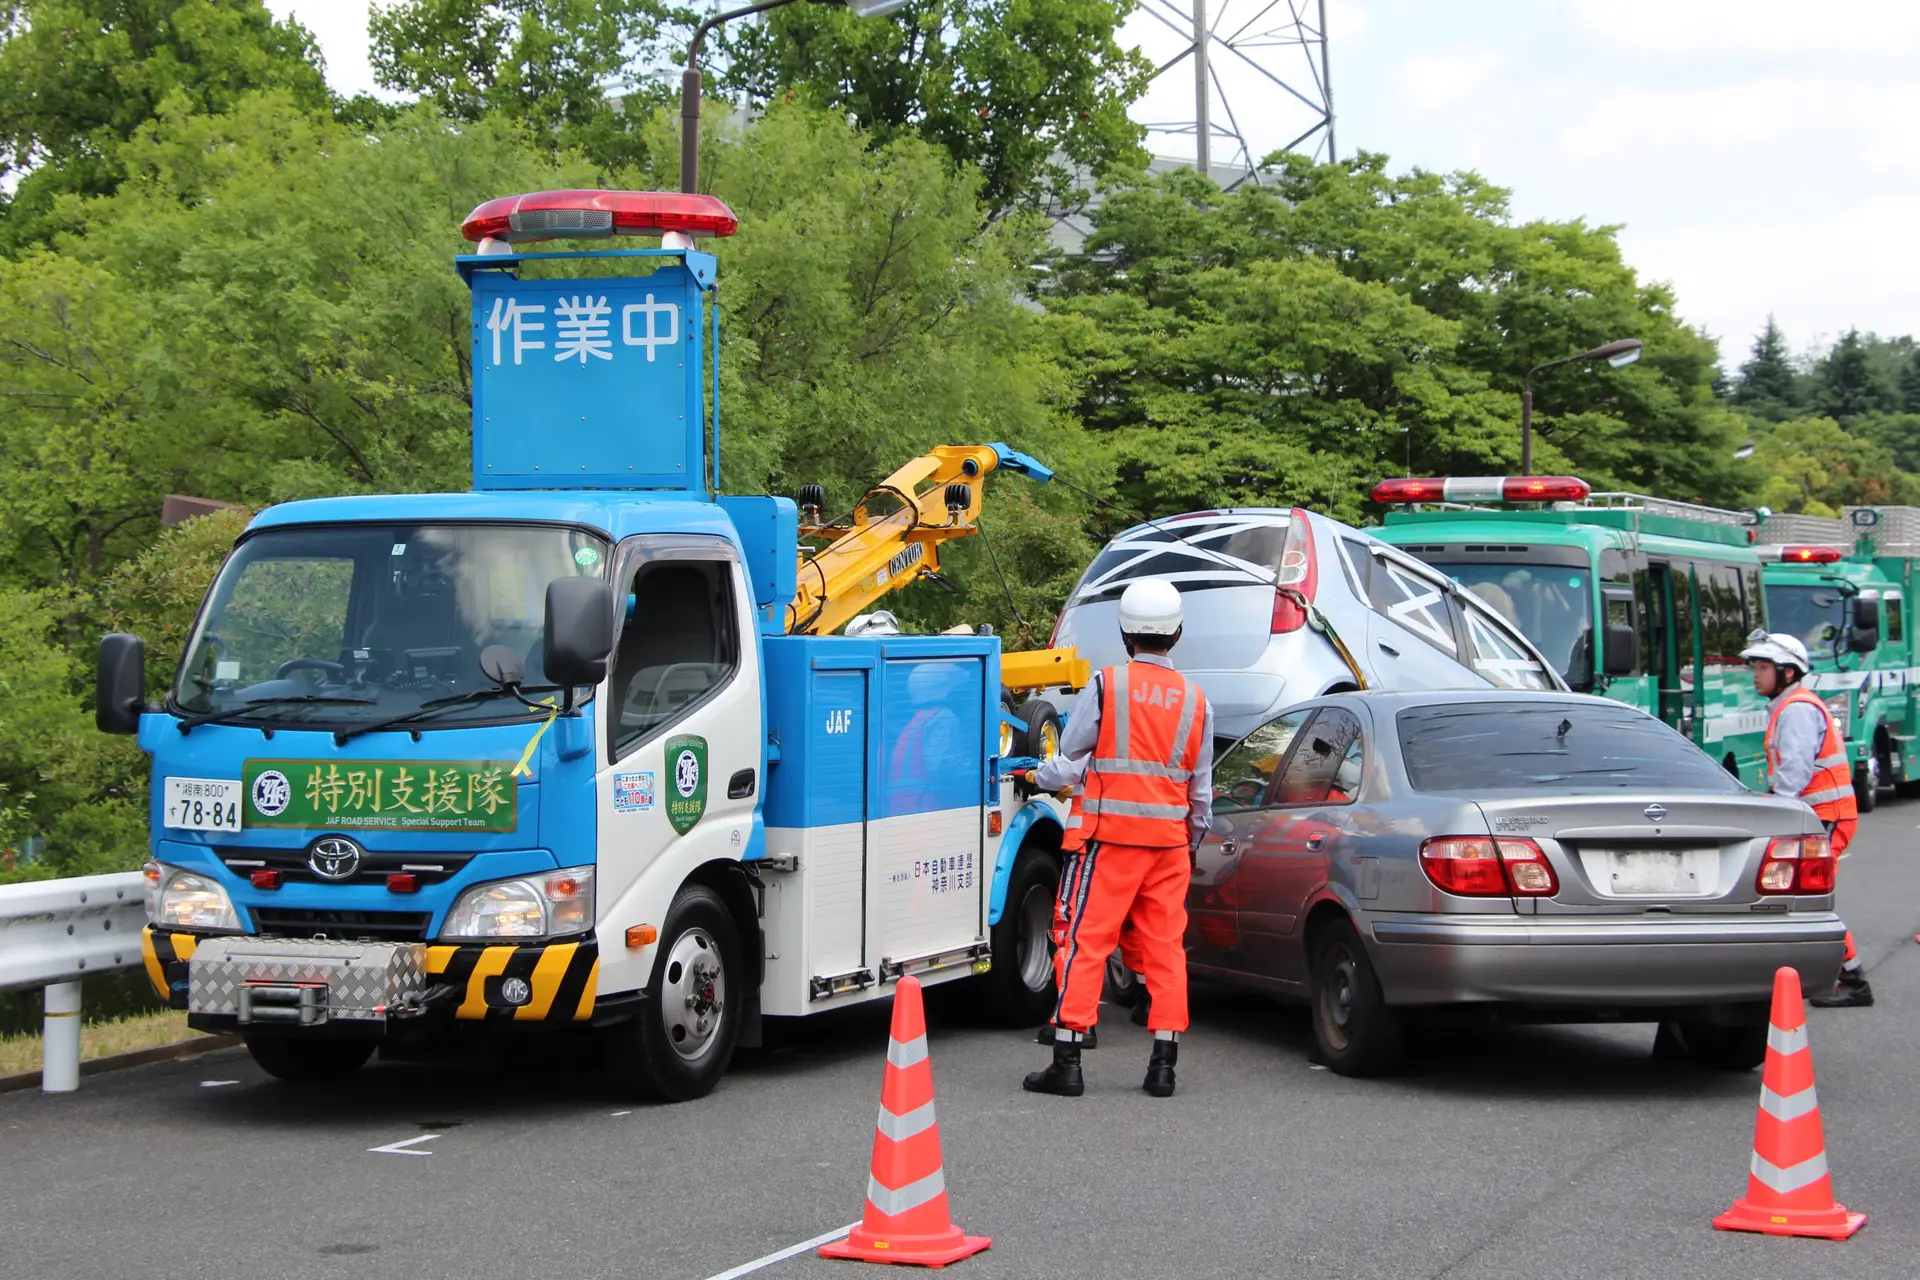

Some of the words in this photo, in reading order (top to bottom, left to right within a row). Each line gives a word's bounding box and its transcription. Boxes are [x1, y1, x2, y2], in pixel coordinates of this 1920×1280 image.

[486, 293, 679, 366] 作業中
[1133, 681, 1181, 710] JAF
[826, 709, 852, 734] JAF
[305, 764, 510, 814] 特別支援隊
[181, 800, 236, 827] 78-84
[326, 816, 340, 825] JAF
[341, 816, 363, 825] ROAD
[364, 817, 397, 826] SERVICE
[402, 817, 429, 827] Special
[430, 817, 462, 828] Support
[463, 818, 486, 827] Team
[1495, 815, 1548, 824] BLUEBIRD
[915, 853, 972, 877] 日本自動車連盟
[932, 872, 972, 894] 神奈川支部
